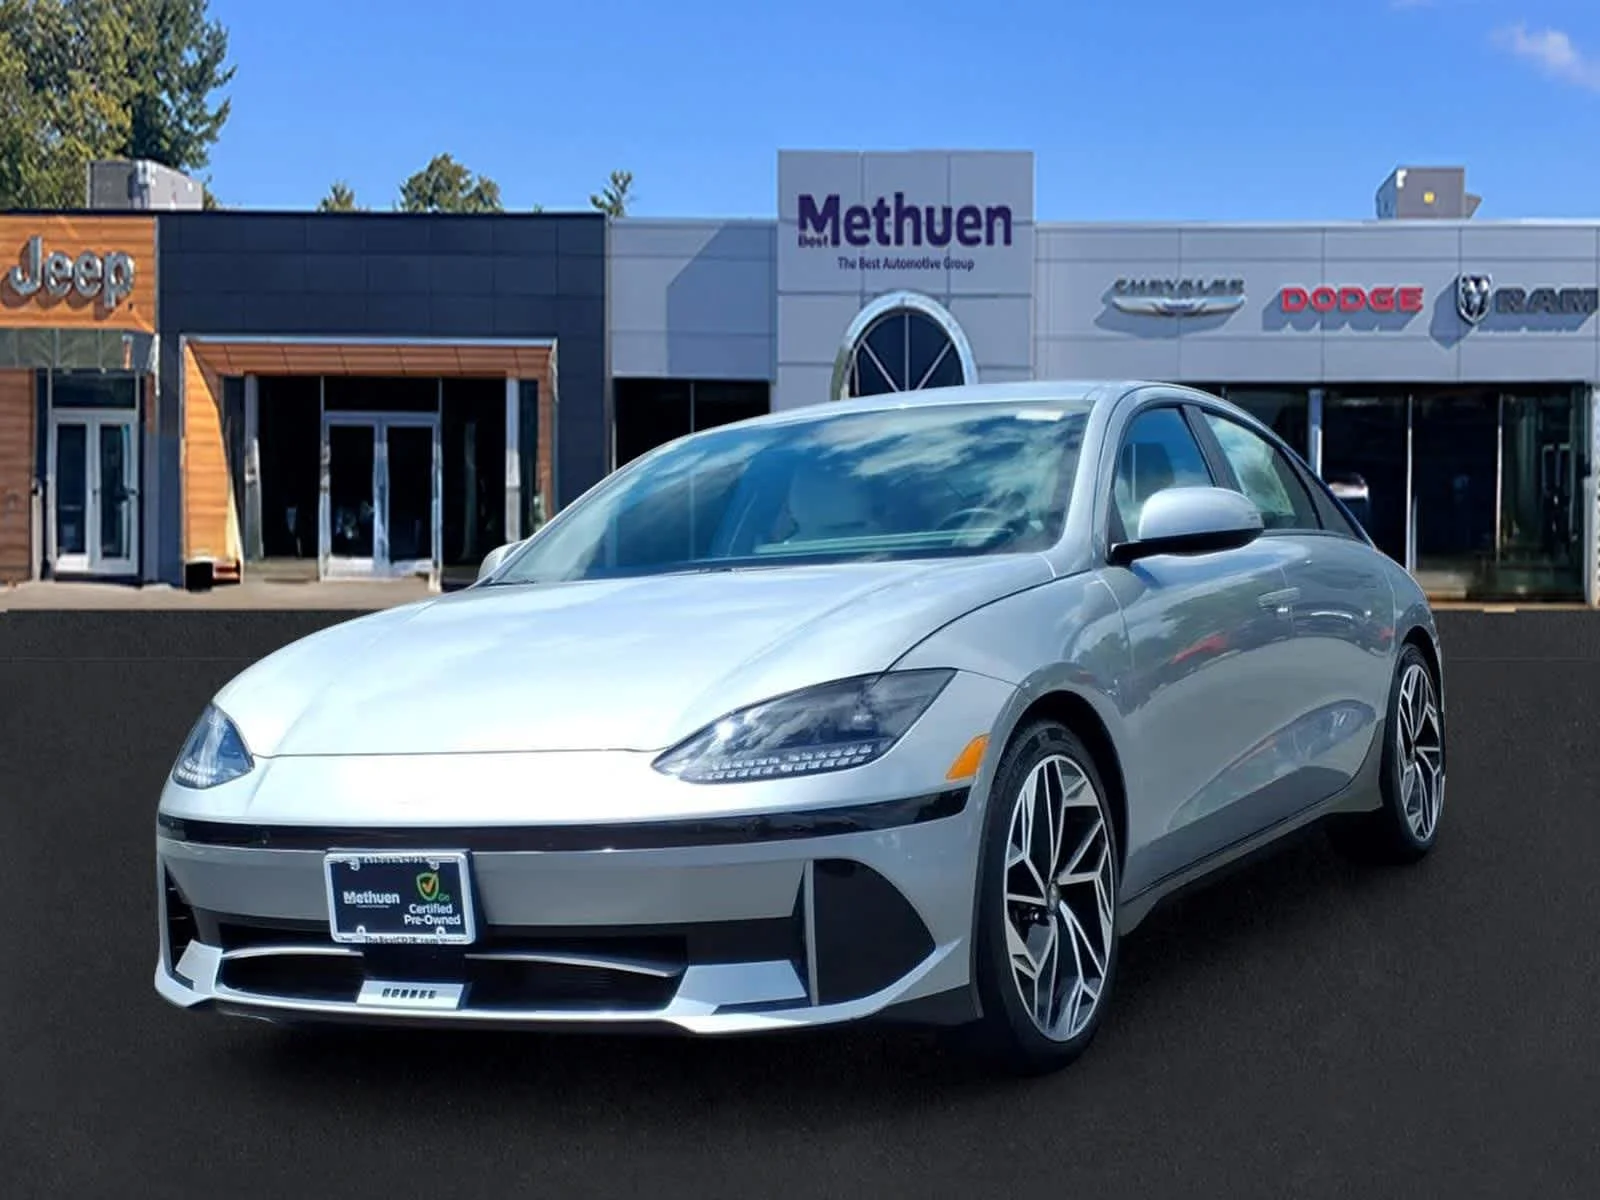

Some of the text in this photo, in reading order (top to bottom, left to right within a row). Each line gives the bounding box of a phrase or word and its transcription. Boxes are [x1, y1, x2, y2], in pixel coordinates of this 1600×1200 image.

[797, 191, 1012, 247] Methuen
[797, 233, 829, 248] Best
[9, 234, 135, 308] Jeep
[838, 256, 975, 273] The Best Automotive Group
[1281, 286, 1424, 312] DODGE
[1495, 287, 1599, 313] RAM
[342, 888, 400, 905] Methuen
[408, 903, 453, 914] Certified
[403, 914, 461, 925] Pre-Owned
